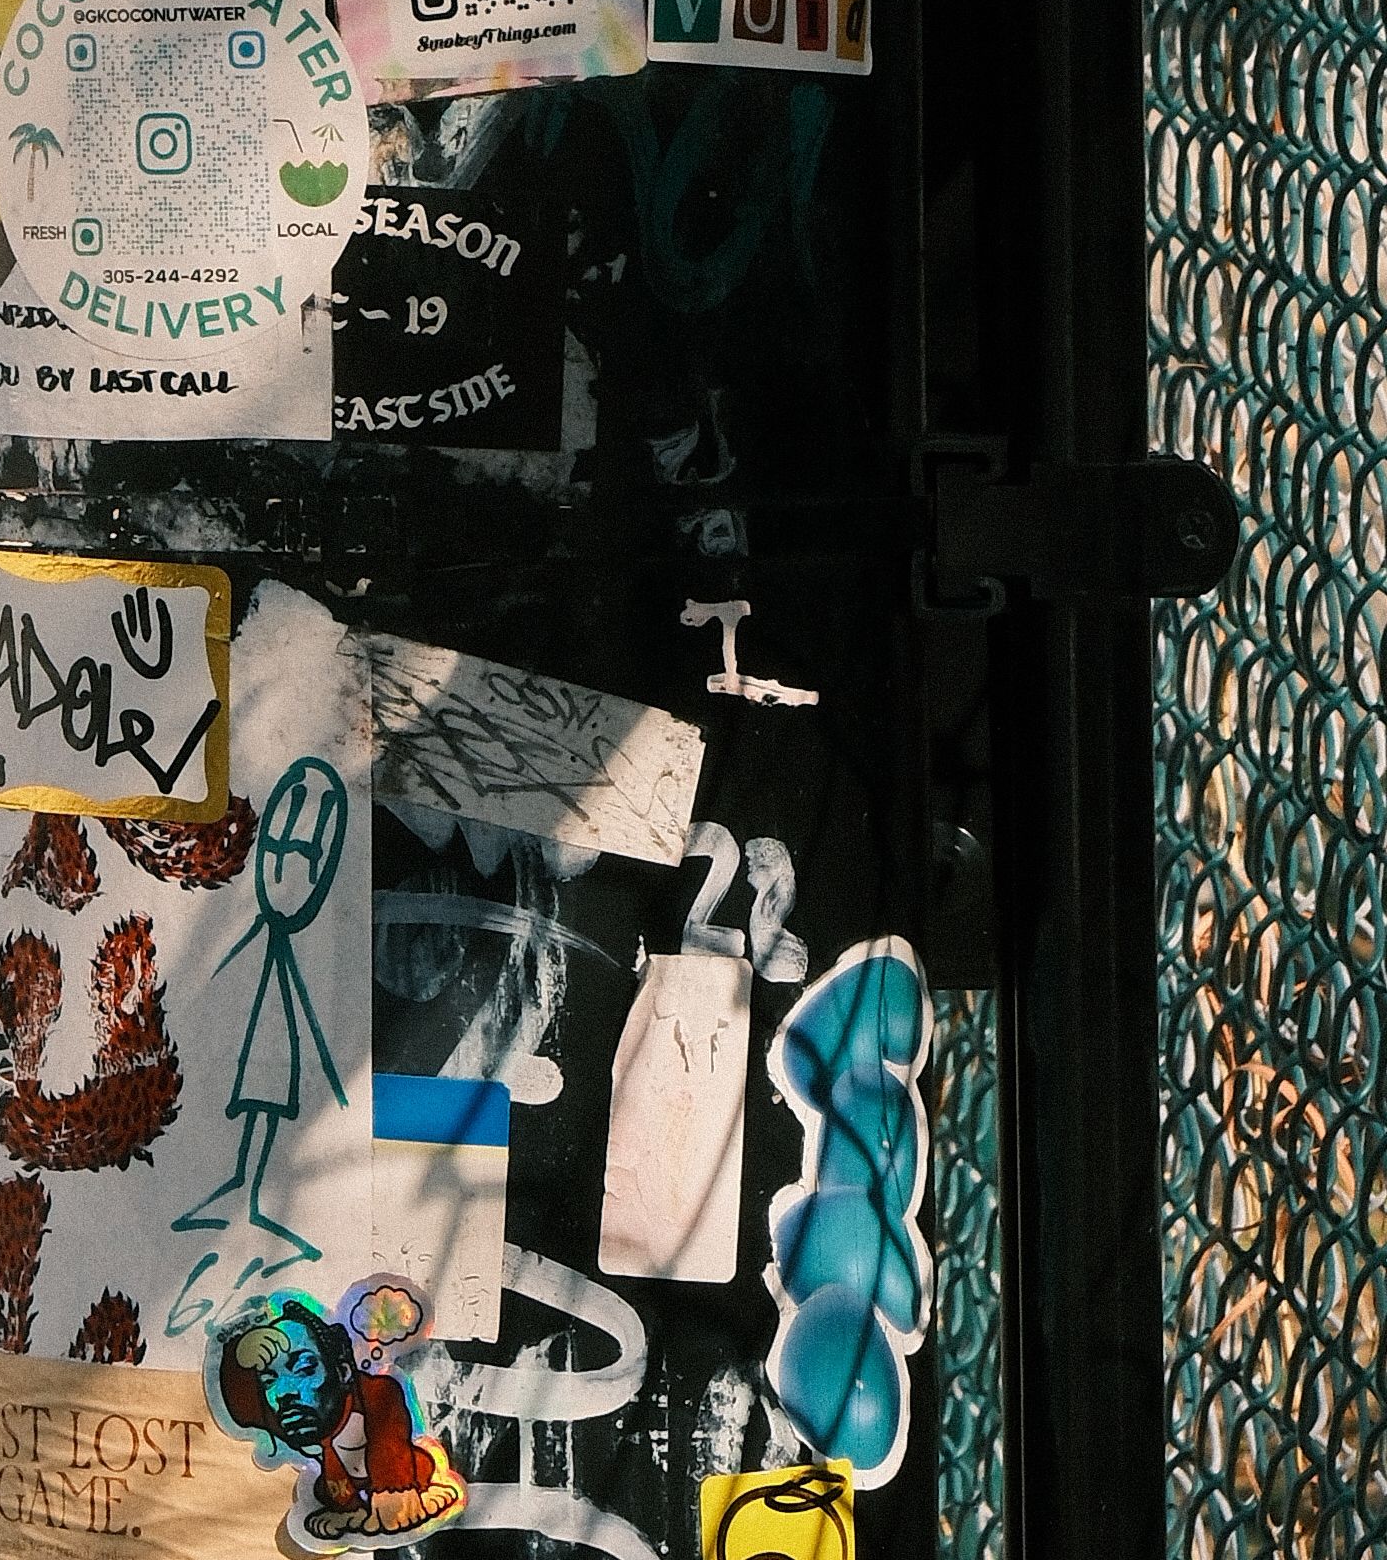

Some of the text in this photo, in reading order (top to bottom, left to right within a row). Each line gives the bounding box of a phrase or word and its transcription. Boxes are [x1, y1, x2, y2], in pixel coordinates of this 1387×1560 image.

[73, 6, 247, 26] @GKCOCONUTWATER
[416, 22, 577, 53] SmokeyThings.com
[22, 221, 339, 241] FRESH LOCAL
[101, 267, 240, 285] 305-244-4292
[58, 269, 287, 340] DELIVERY
[403, 294, 448, 336] 19
[35, 366, 75, 393] BY
[428, 363, 517, 424] SIDE
[67, 1410, 207, 1479] LOST
